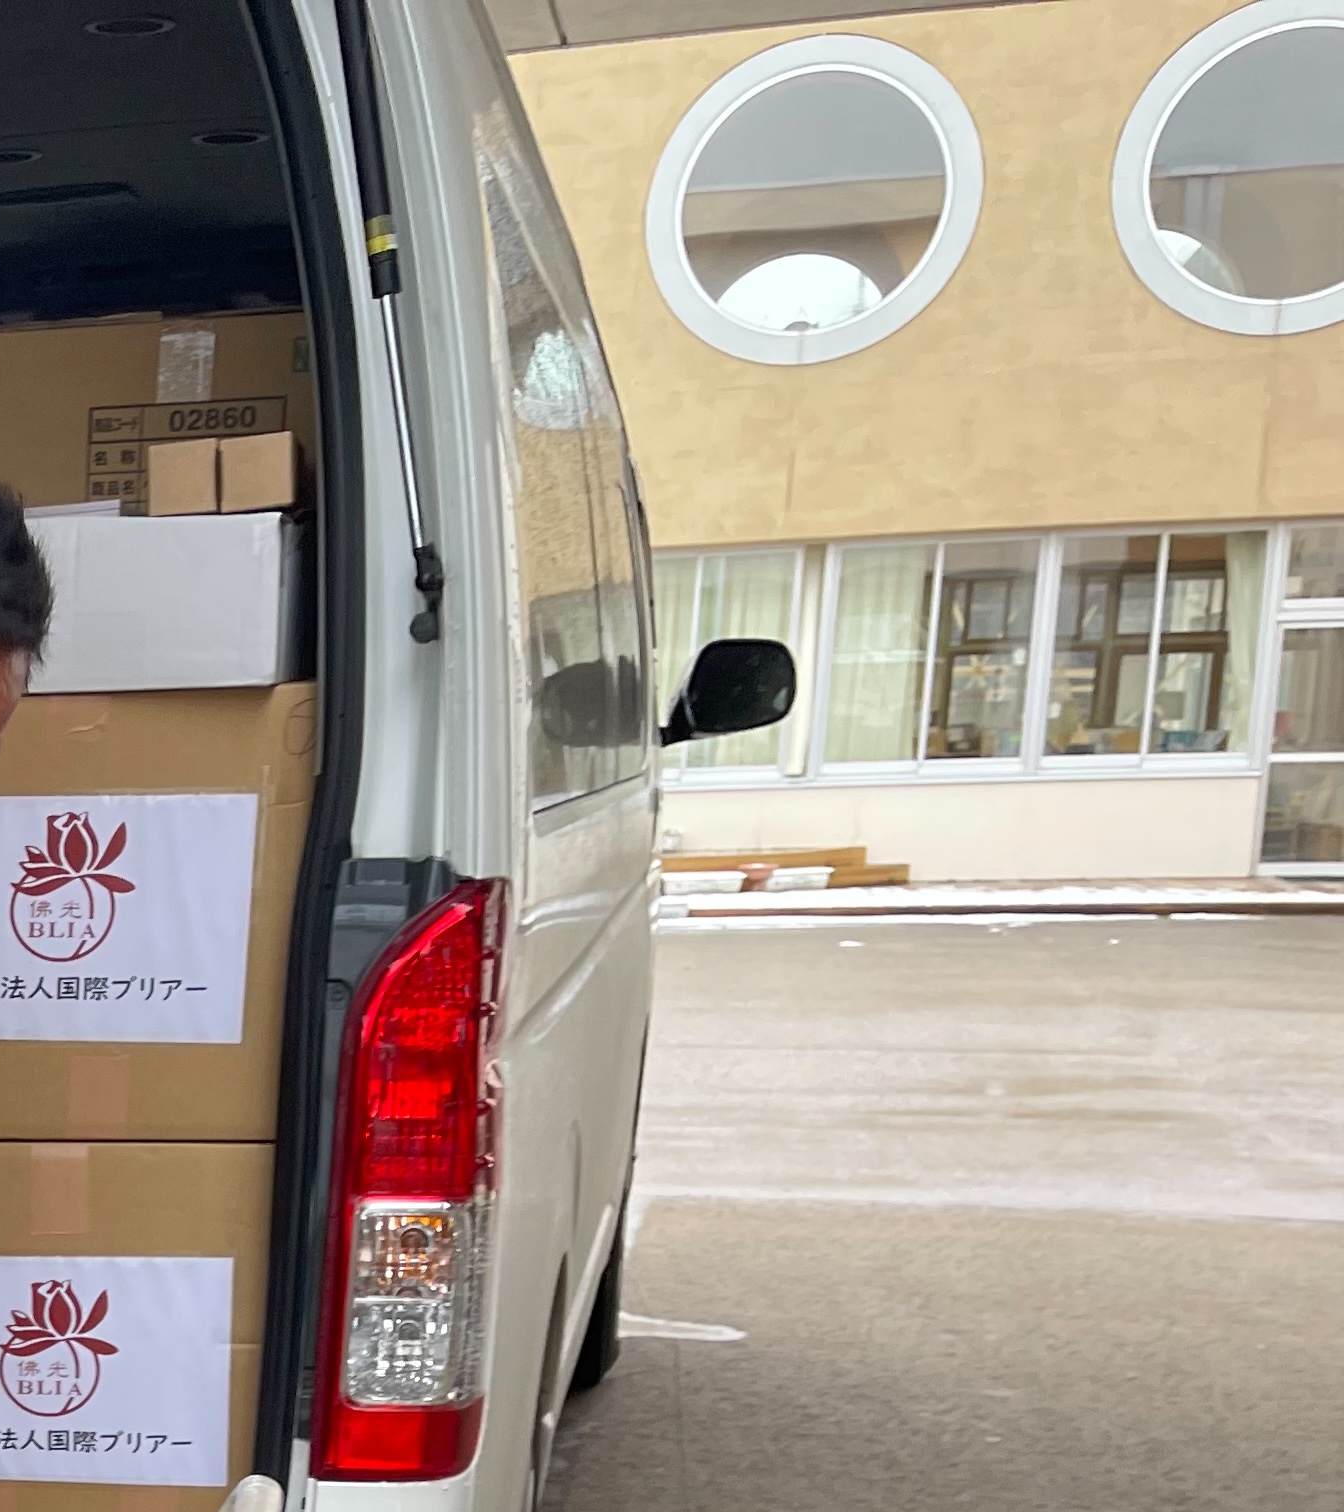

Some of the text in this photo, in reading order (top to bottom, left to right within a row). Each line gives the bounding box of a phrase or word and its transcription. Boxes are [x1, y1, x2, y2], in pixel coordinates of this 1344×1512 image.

[168, 405, 257, 432] 02860
[27, 921, 97, 940] BLIA
[16, 1379, 83, 1397] BLIA
